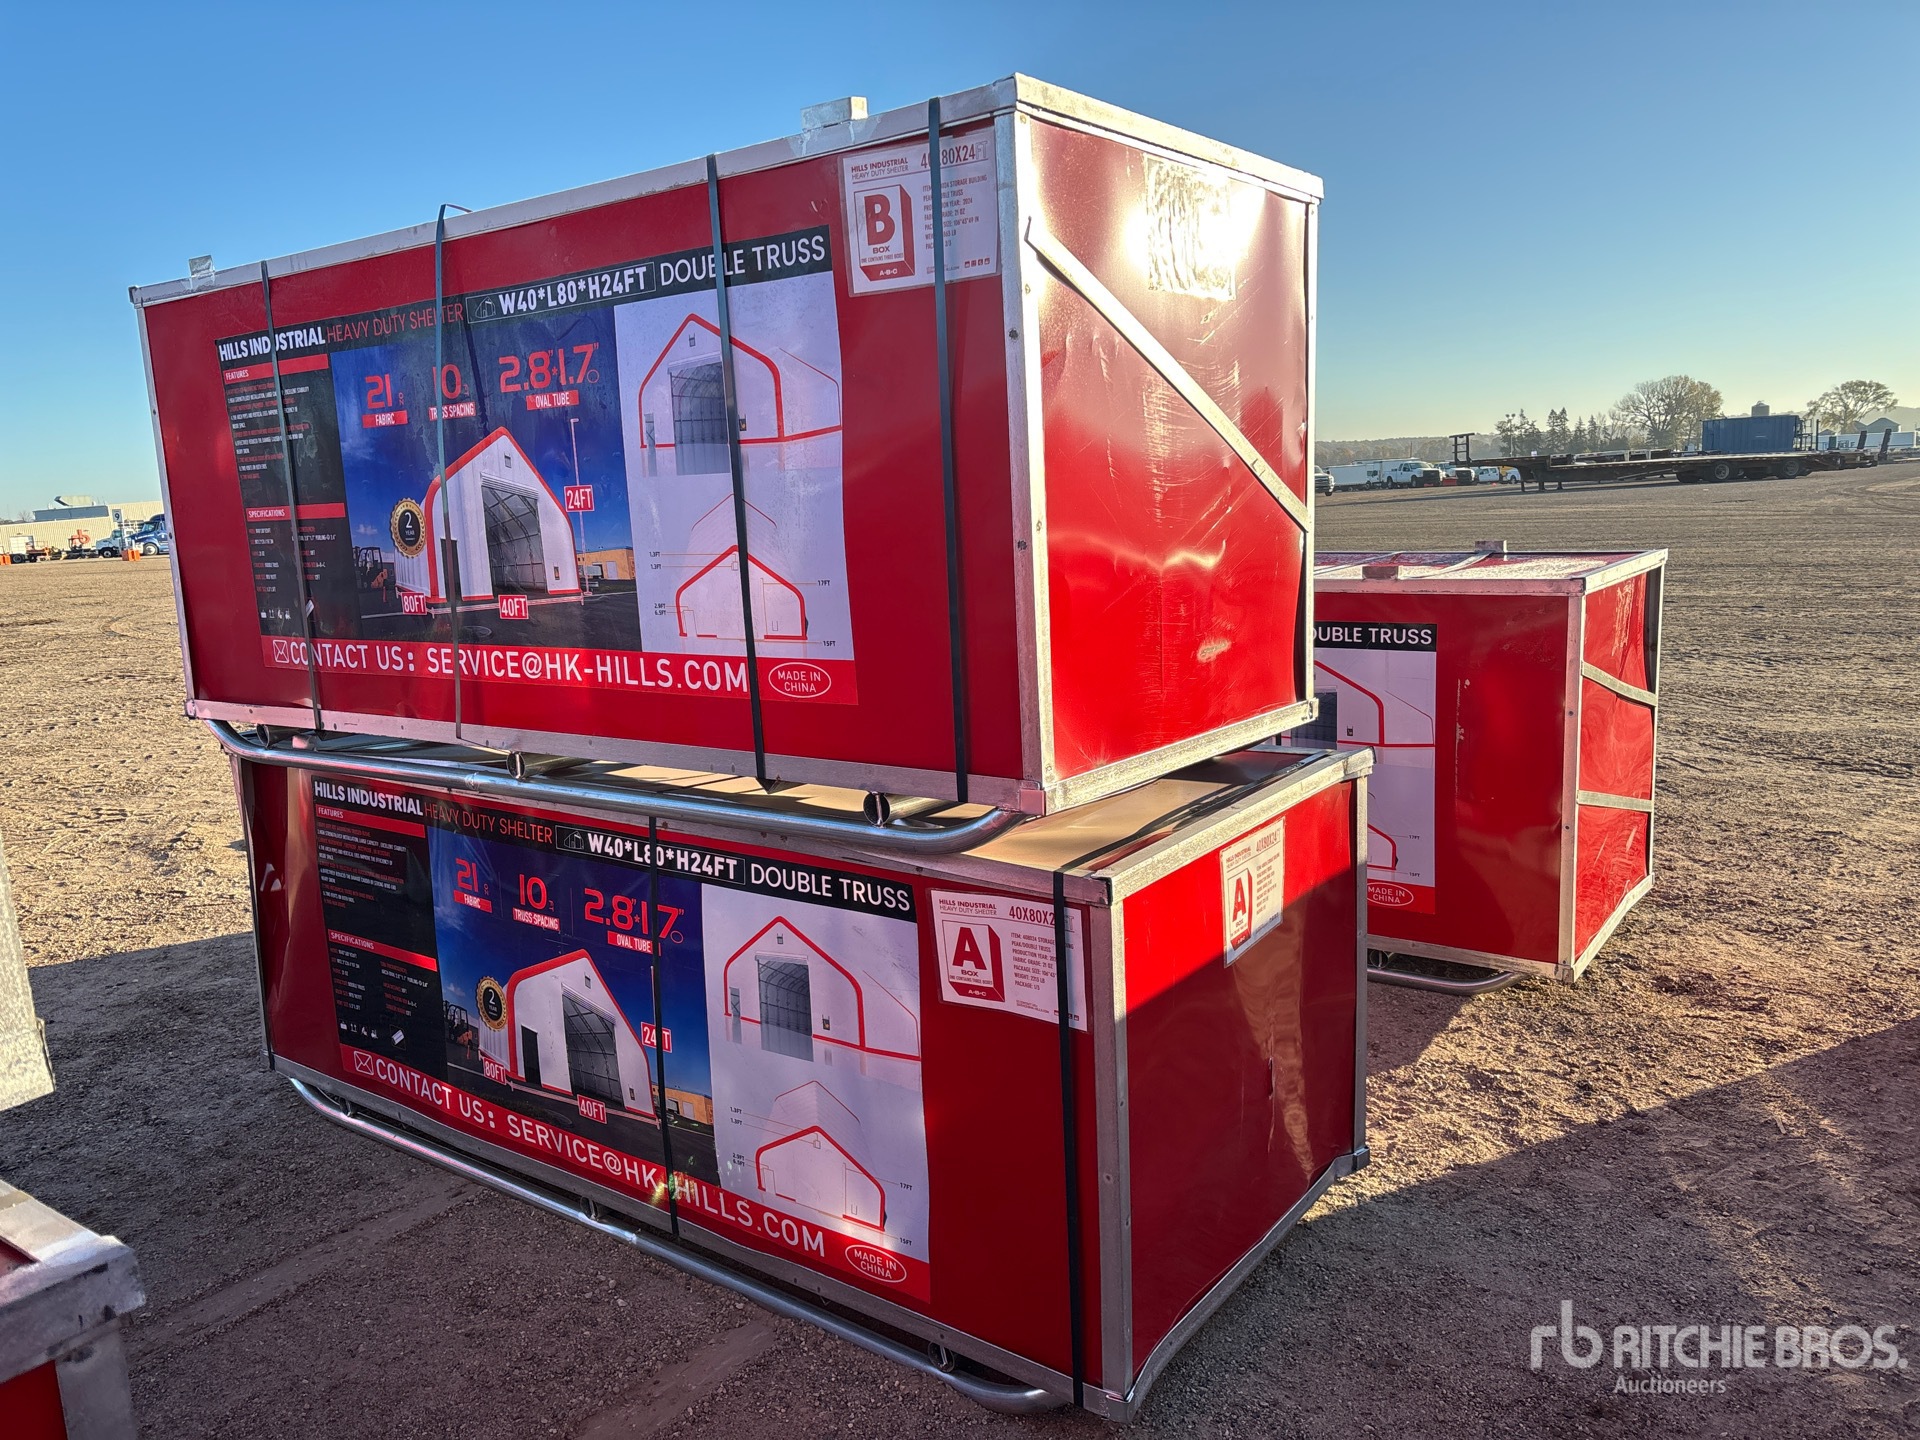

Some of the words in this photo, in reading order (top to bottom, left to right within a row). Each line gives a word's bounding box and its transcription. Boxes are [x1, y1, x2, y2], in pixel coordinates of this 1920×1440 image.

[851, 163, 868, 173] HILLS
[869, 157, 909, 170] INDUSTRIAL
[852, 171, 870, 181] HEAVY
[870, 168, 886, 178] DUTY
[887, 165, 909, 176] SHELTER
[864, 193, 896, 246] B
[872, 245, 891, 254] BOX
[660, 249, 746, 287] DOUBLE
[752, 235, 826, 272] TRUSS
[218, 339, 249, 362] HILLS
[327, 319, 370, 343] HEAVY
[373, 314, 407, 336] DUTY
[225, 369, 250, 382] FEATURES
[365, 373, 393, 409] 21
[535, 394, 552, 408] OVAL
[553, 391, 570, 407] TUBE
[430, 406, 448, 420] TRSS
[449, 402, 475, 418] SPACING
[565, 488, 592, 510] 24FT
[248, 508, 285, 519] SPECIFICATIONS
[405, 512, 413, 528] 2
[403, 595, 426, 614] 80FT
[501, 597, 528, 618] 40FT
[1313, 627, 1362, 642] UBLE
[1368, 628, 1432, 645] TRUSS
[290, 641, 368, 669] CONTACT
[376, 645, 415, 672] US:
[427, 647, 749, 693] SERVICE@HK-HILLS.COM
[777, 670, 807, 681] MADE
[810, 671, 822, 682] IN
[784, 681, 818, 693] CHINA
[314, 780, 346, 802] HILLS
[347, 787, 423, 817] INDUSTRIAL
[424, 803, 459, 825] HEAVY
[462, 810, 496, 833] DUTY
[499, 816, 553, 844] SHELTER
[318, 806, 344, 819] FEATURES
[455, 858, 479, 892] 21
[519, 873, 547, 910] 10
[751, 863, 833, 898] DOUBLE
[839, 878, 911, 912] TRUSS
[1367, 886, 1393, 895] MADE
[1395, 889, 1405, 898] IN
[939, 898, 956, 907] HILLS
[957, 901, 997, 910] INDUSTRIAL
[1232, 876, 1247, 922] A
[1372, 893, 1401, 903] CHINA
[514, 909, 534, 923] TRUSS
[533, 914, 559, 930] SPACING
[974, 908, 998, 916] SHELTER
[1009, 906, 1075, 931] 40X80X2T
[330, 932, 375, 950] SPECIFICATIONS
[616, 933, 633, 949] OVAL
[634, 937, 653, 953] TUBE
[952, 926, 987, 970] A
[961, 969, 979, 977] BOX
[488, 989, 496, 1005] 2
[643, 1026, 671, 1050] 24T
[485, 1060, 505, 1082] 80FT
[375, 1059, 452, 1109] CONTACT
[459, 1093, 496, 1128] US:
[579, 1097, 606, 1122] 40FT
[899, 1182, 913, 1191] 17FT
[899, 1237, 912, 1246] 15FT
[853, 1249, 882, 1266] MADE
[885, 1257, 897, 1271] IN
[860, 1260, 893, 1279] CHINA
